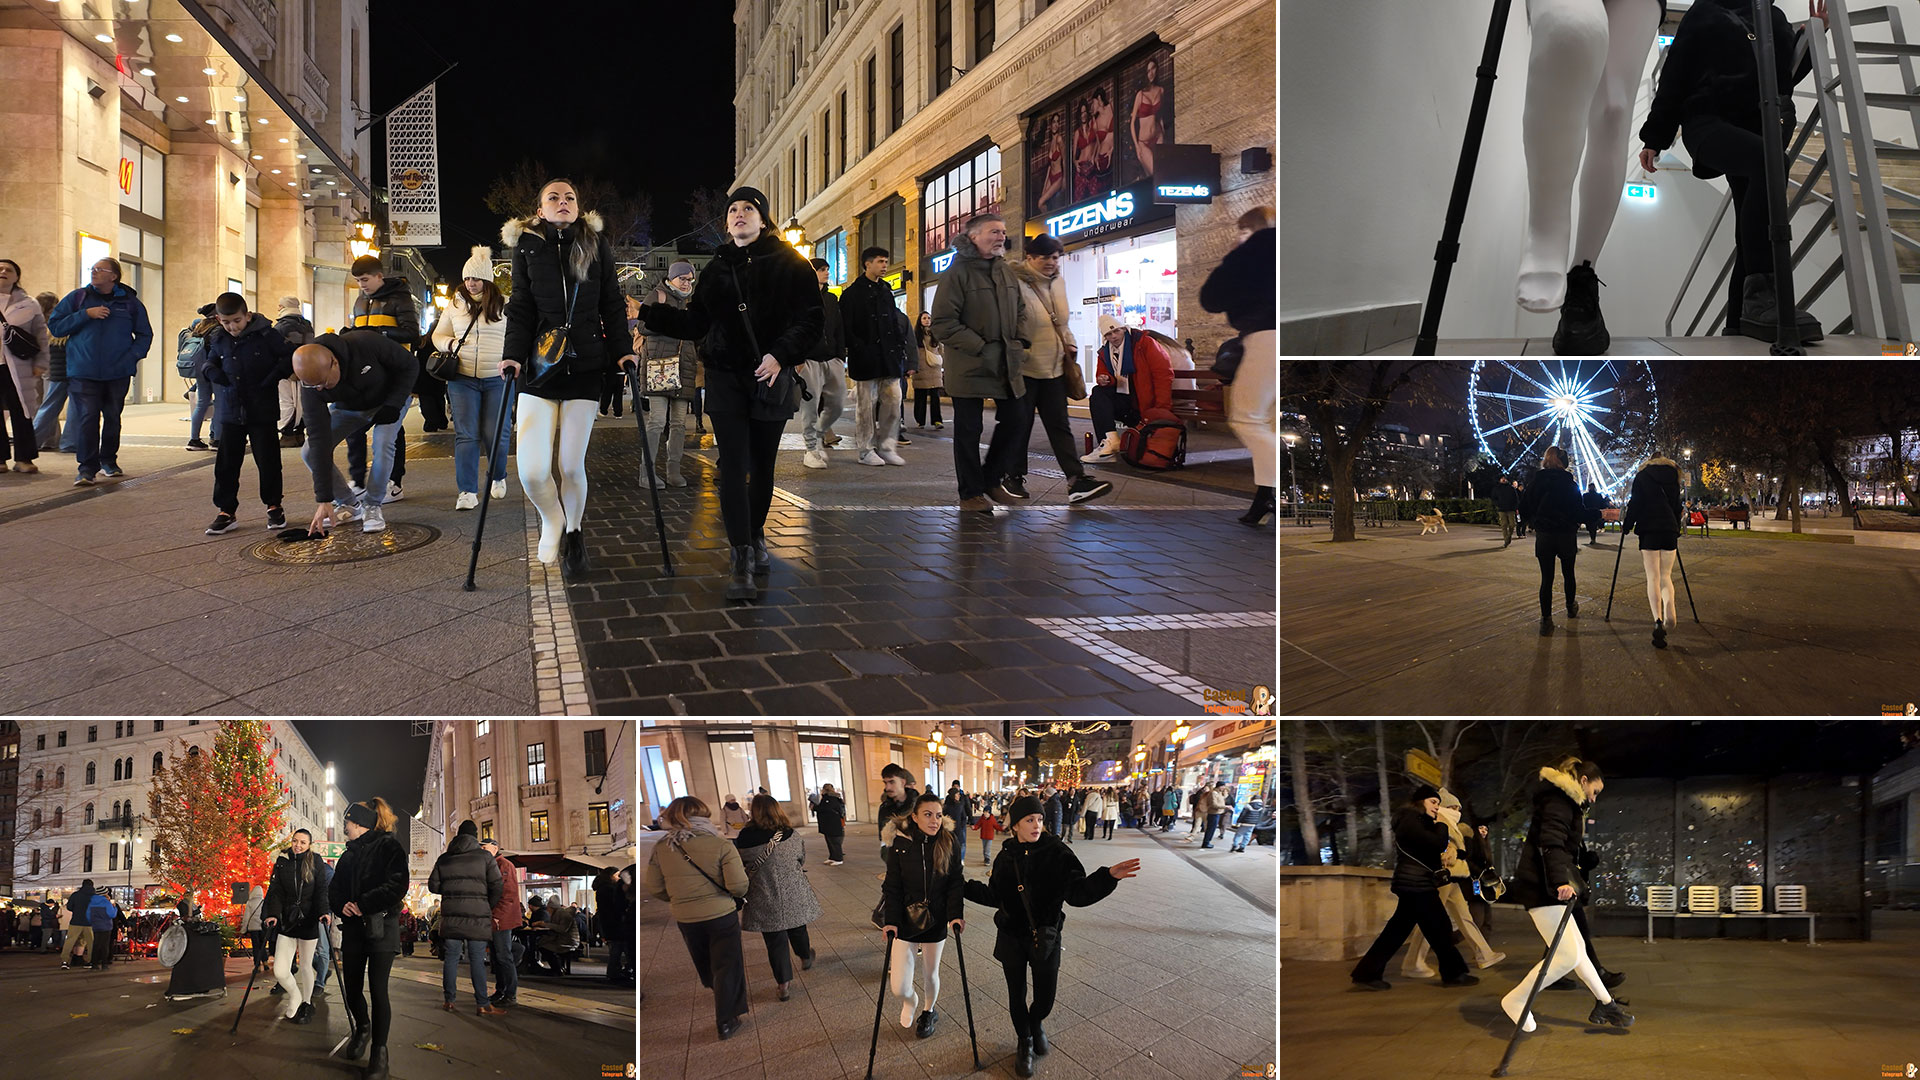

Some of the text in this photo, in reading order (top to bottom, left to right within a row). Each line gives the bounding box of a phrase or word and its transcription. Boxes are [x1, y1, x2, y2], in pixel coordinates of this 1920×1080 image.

[393, 173, 430, 182] Hard Rock
[1046, 190, 1134, 238] TEZENIS
[1083, 216, 1134, 238] underwear
